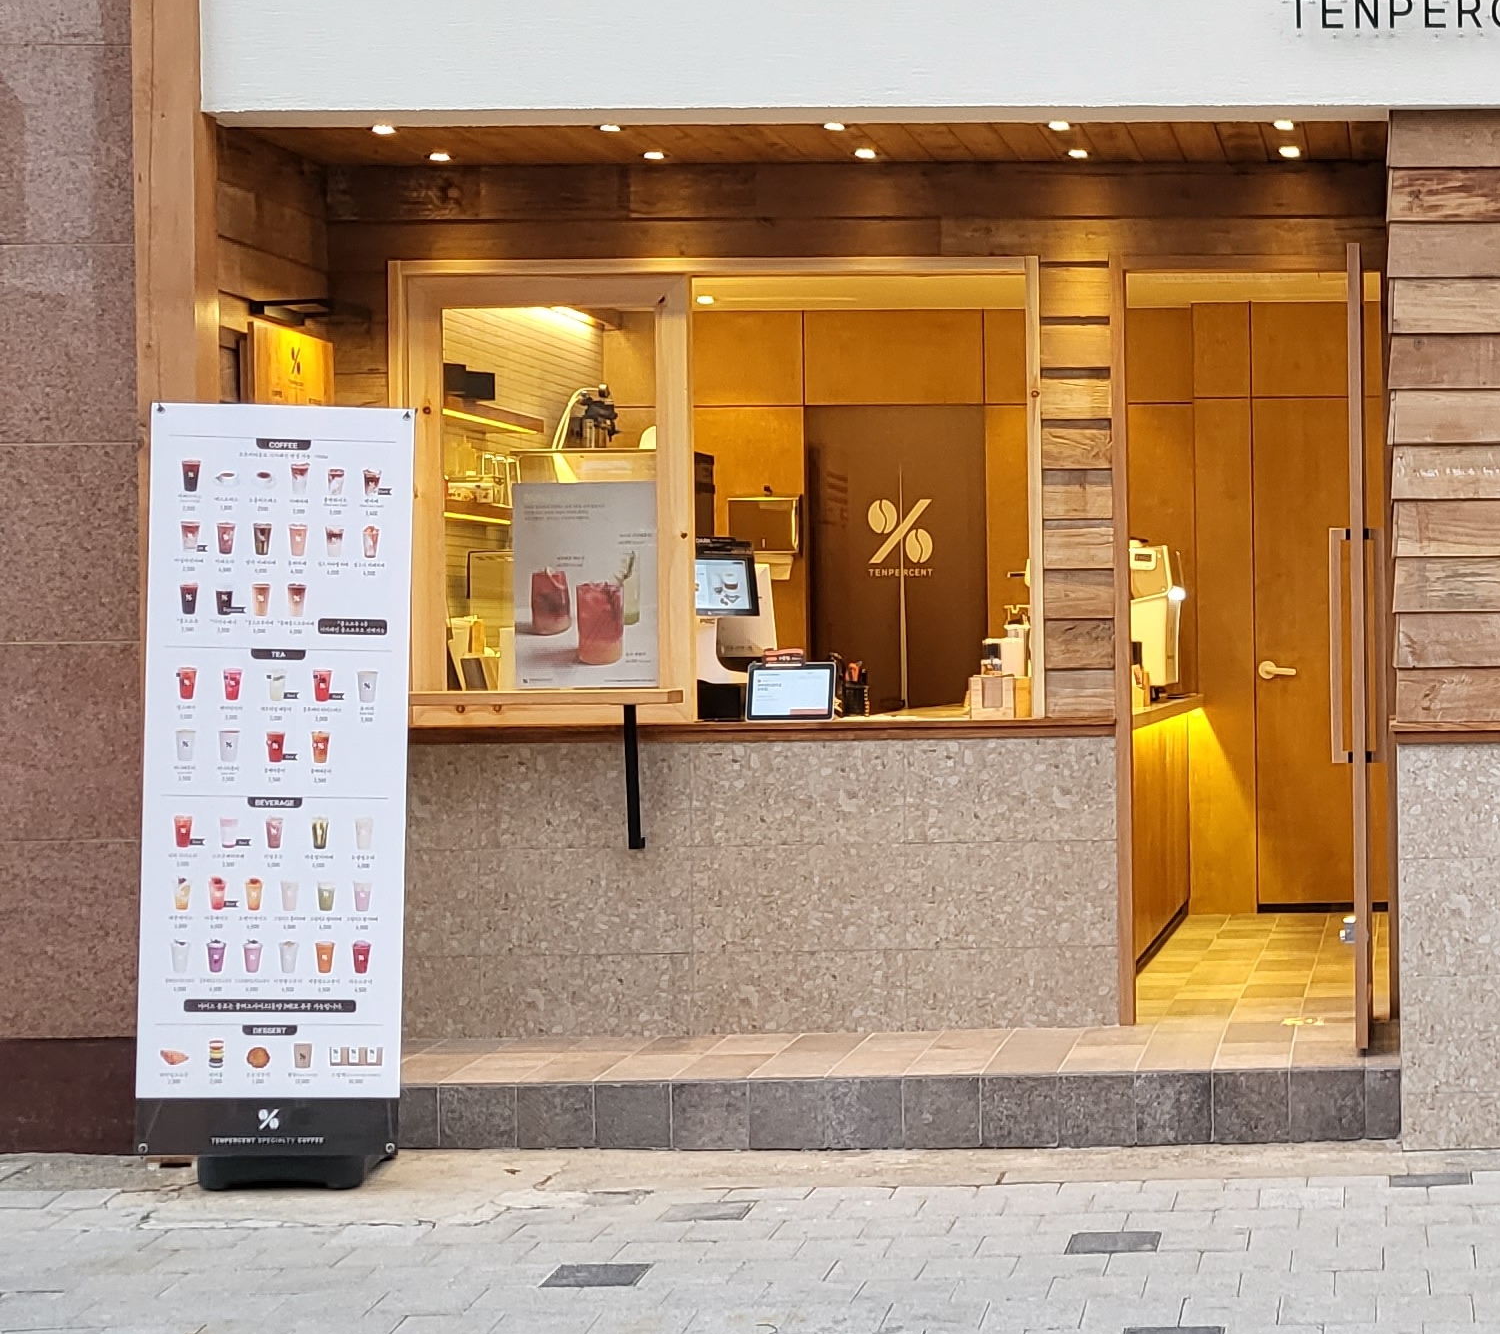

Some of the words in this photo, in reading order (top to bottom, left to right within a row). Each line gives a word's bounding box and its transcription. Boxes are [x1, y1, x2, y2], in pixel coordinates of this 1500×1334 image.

[268, 441, 298, 450] COFFEE
[868, 568, 934, 577] TENPERCENT
[271, 650, 286, 658] TEA
[255, 799, 295, 807] BEVERAGE
[252, 1027, 287, 1035] DESSERT
